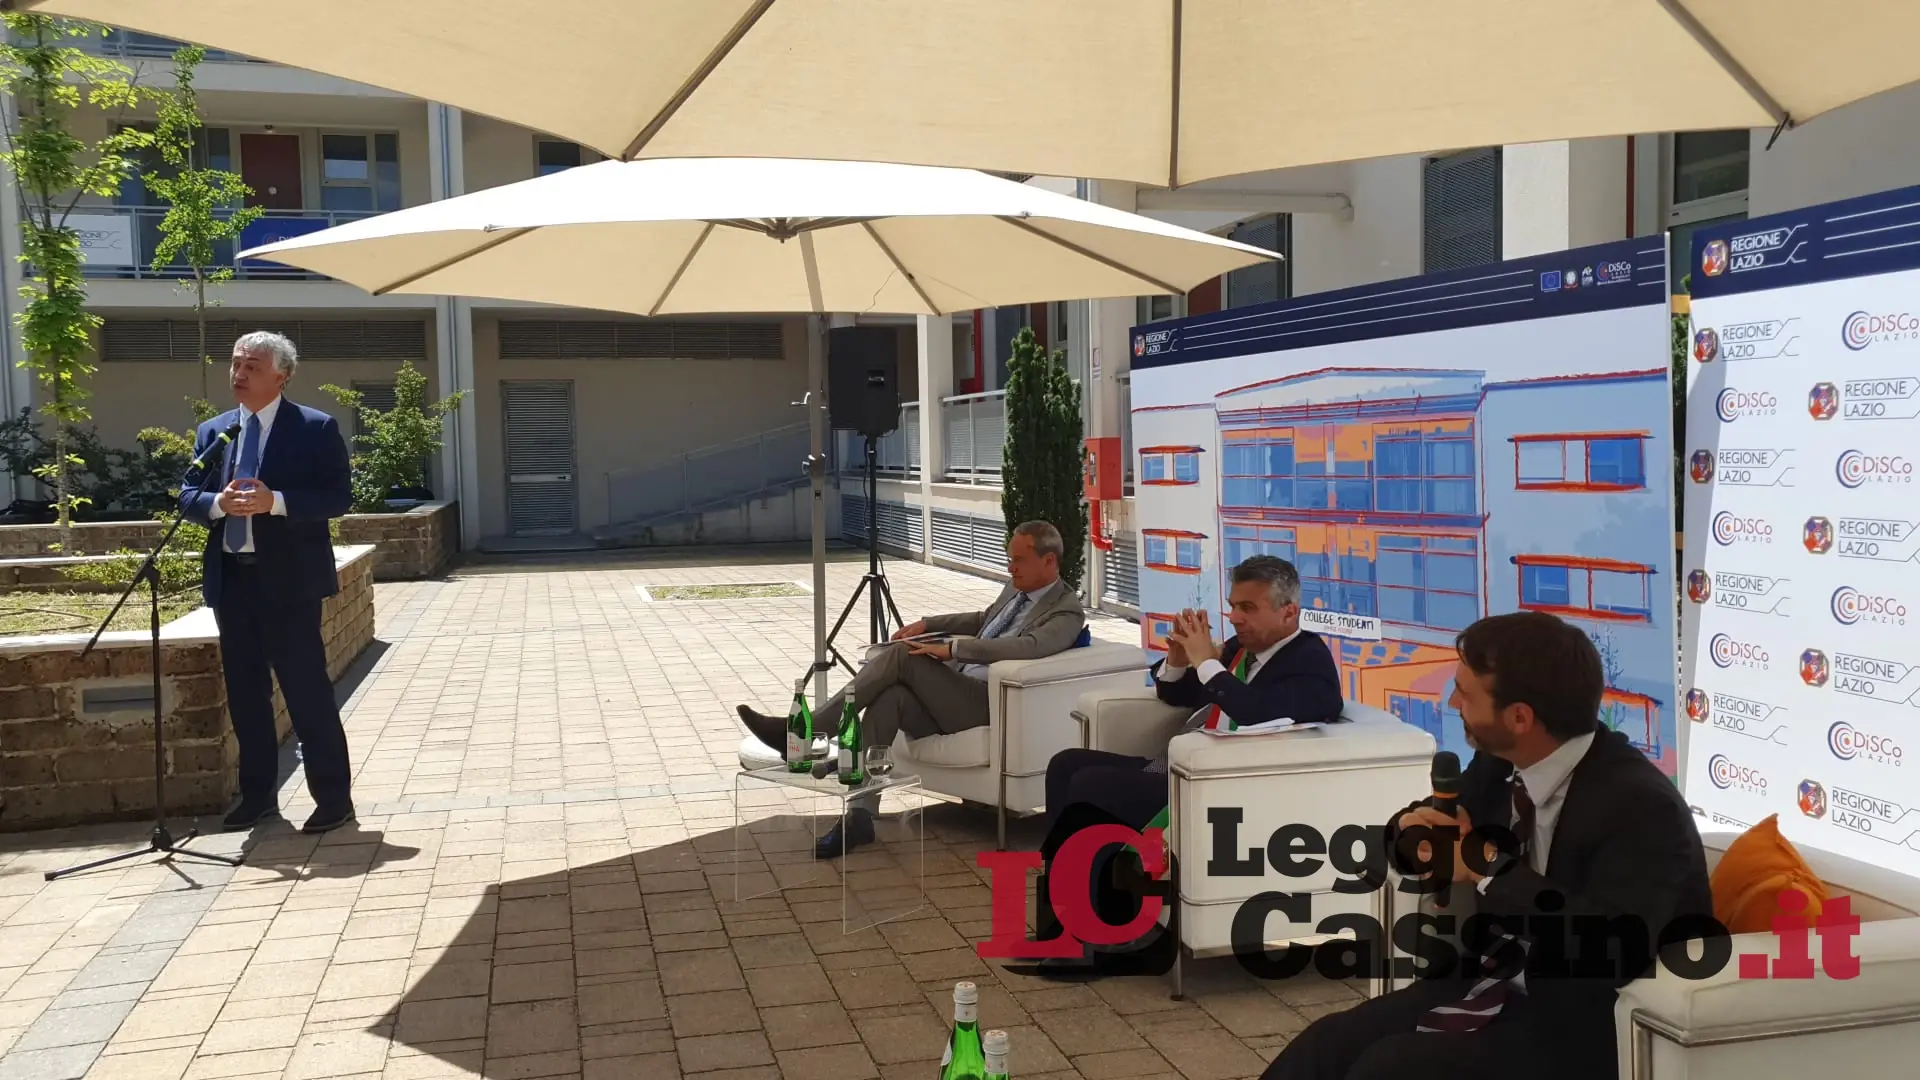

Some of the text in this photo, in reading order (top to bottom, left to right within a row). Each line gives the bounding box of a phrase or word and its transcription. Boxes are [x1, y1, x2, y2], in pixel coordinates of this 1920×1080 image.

[1730, 232, 1781, 252] REGIONE
[1730, 253, 1764, 270] LAZIO
[1869, 313, 1919, 333] DiSCo
[1722, 324, 1773, 340] REGIONE
[1874, 331, 1918, 342] LAZIO
[1721, 344, 1755, 359] LAZIO
[1844, 381, 1907, 397] REGIONE
[1737, 391, 1777, 408] DiSCo
[1844, 403, 1885, 417] LAZIO
[1719, 451, 1768, 465] REGIONE
[1863, 456, 1913, 474] DiSCo
[1718, 470, 1751, 483] LAZIO
[1867, 475, 1911, 483] LAZIO
[1733, 518, 1772, 535] DiSCo
[1839, 520, 1900, 537] REGIONE
[1838, 541, 1879, 556] LAZIO
[1715, 574, 1764, 592] REGIONE
[1715, 592, 1747, 608] LAZIO
[1857, 594, 1906, 617] DiSCo
[1304, 611, 1335, 625] COLLEGE
[1862, 614, 1905, 626] LAZIO
[1731, 641, 1769, 662] DiSCo
[1834, 656, 1895, 679] REGIONE
[1834, 675, 1874, 695] LAZIO
[1713, 695, 1761, 717] REGIONE
[1713, 712, 1745, 731] LAZIO
[1854, 732, 1902, 758] DiSCo
[1859, 751, 1901, 767] LAZIO
[1729, 763, 1768, 789] DiSCo
[1832, 789, 1892, 819] REGIONE
[1831, 809, 1872, 832] LAZIO
